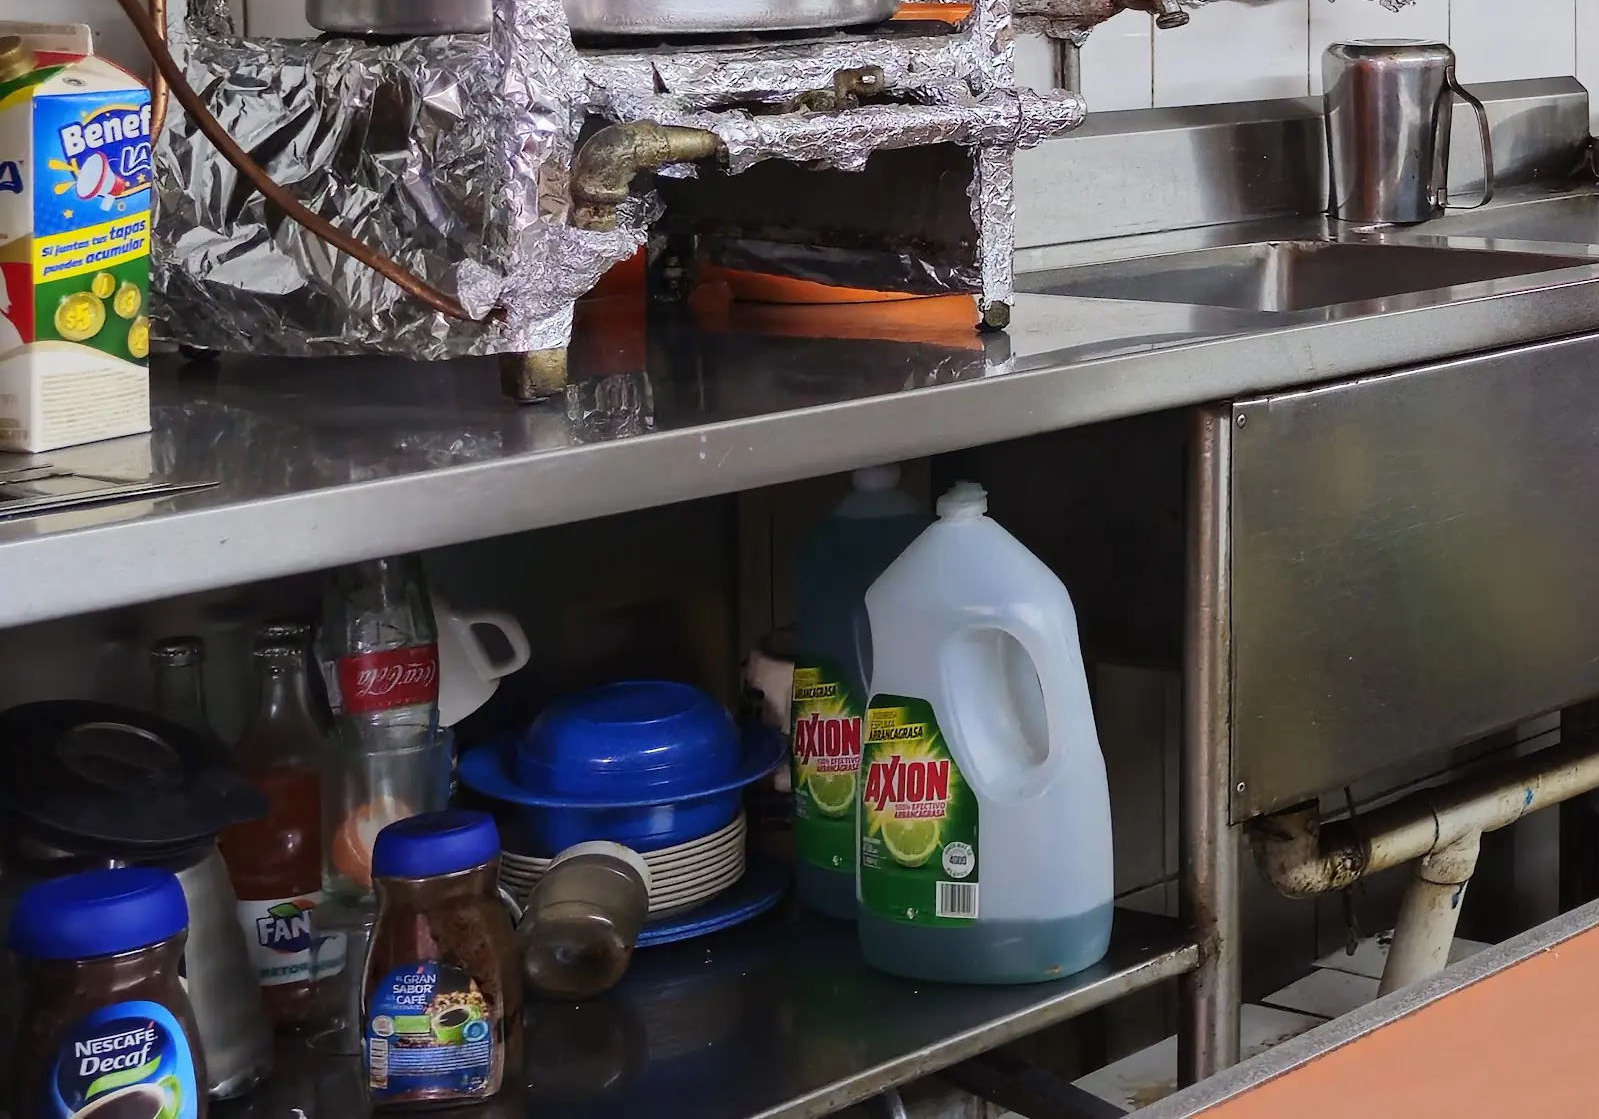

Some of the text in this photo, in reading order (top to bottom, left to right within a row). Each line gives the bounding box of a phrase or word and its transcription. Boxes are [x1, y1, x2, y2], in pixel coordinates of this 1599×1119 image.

[41, 246, 53, 257] Si
[109, 219, 146, 241] tapas
[85, 237, 145, 264] acumular
[795, 713, 861, 765] AXION
[869, 726, 923, 741] ARRANCAGRASA
[864, 756, 949, 811] AXION
[912, 802, 946, 811] EFECTIVO
[393, 984, 433, 994] SABOR
[404, 974, 436, 985] GRAN
[396, 994, 427, 1005] CAFÉ
[79, 1042, 153, 1076] Decaf
